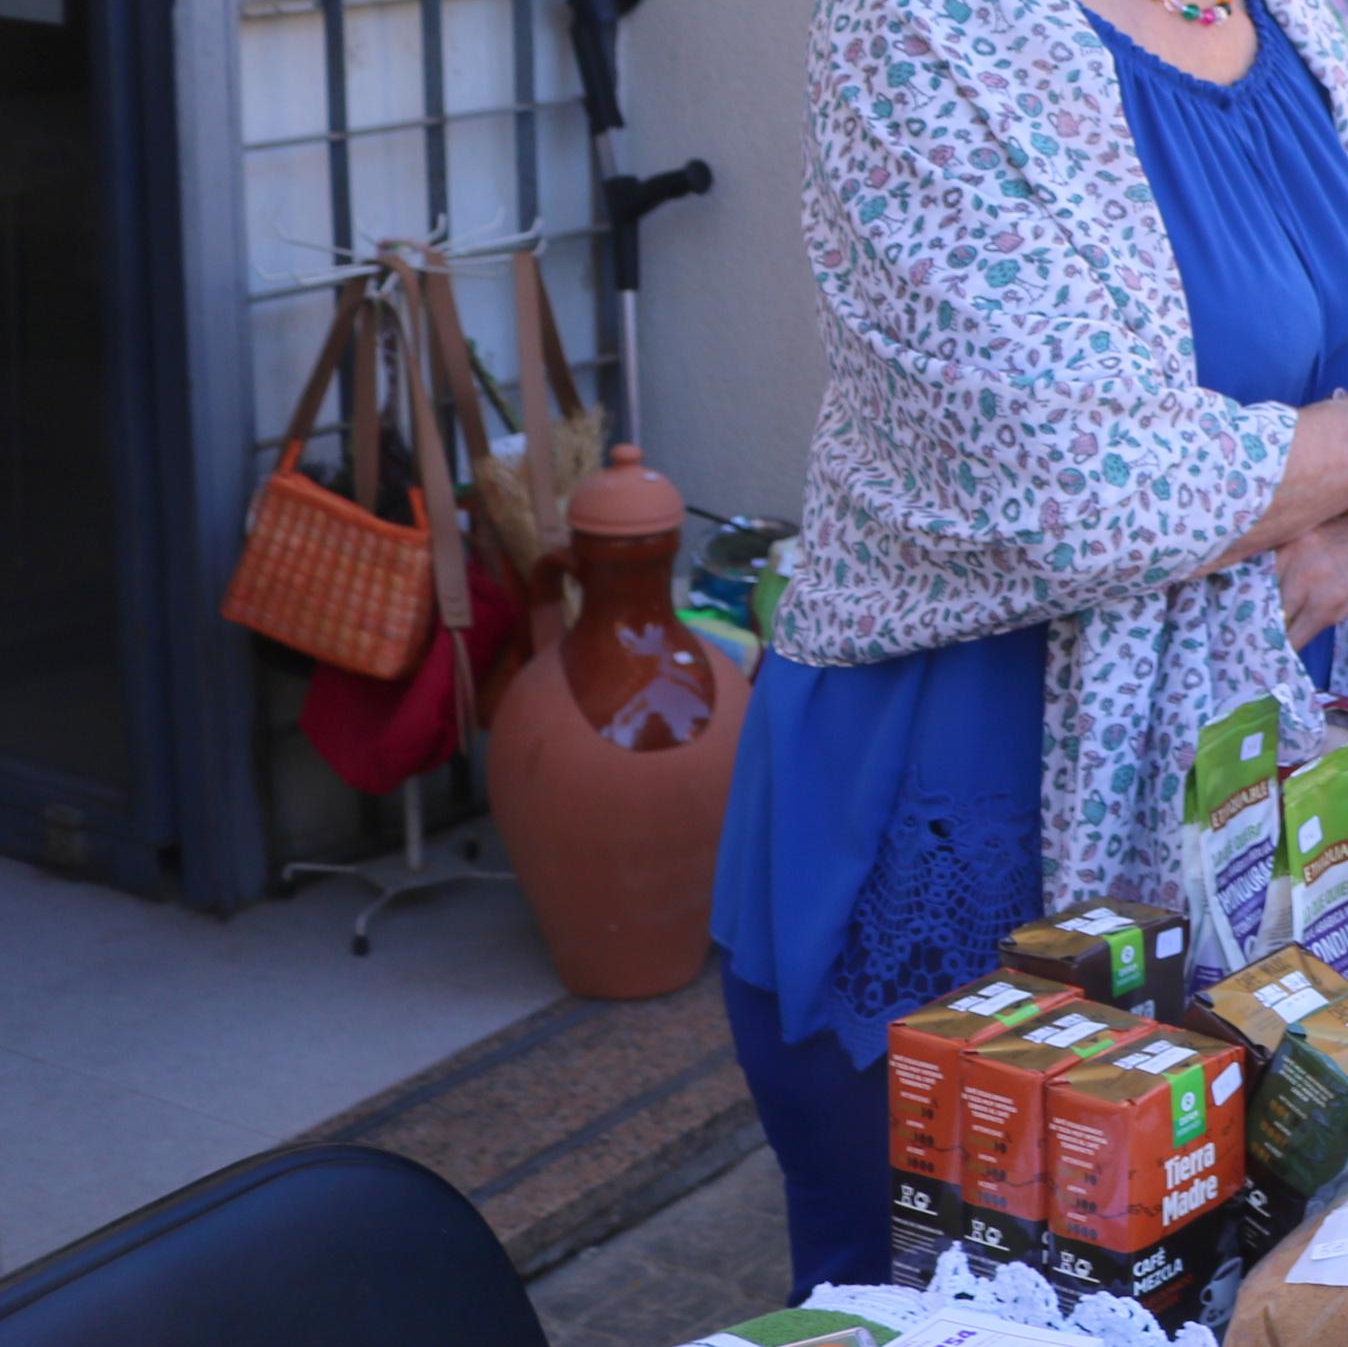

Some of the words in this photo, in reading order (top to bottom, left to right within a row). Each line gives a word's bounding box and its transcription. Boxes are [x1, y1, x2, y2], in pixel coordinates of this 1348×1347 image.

[1164, 1141, 1216, 1190] Tierra
[1162, 1174, 1218, 1227] Madre
[1132, 1258, 1184, 1297] MEZCLA
[1133, 1247, 1167, 1276] CAFÉ
